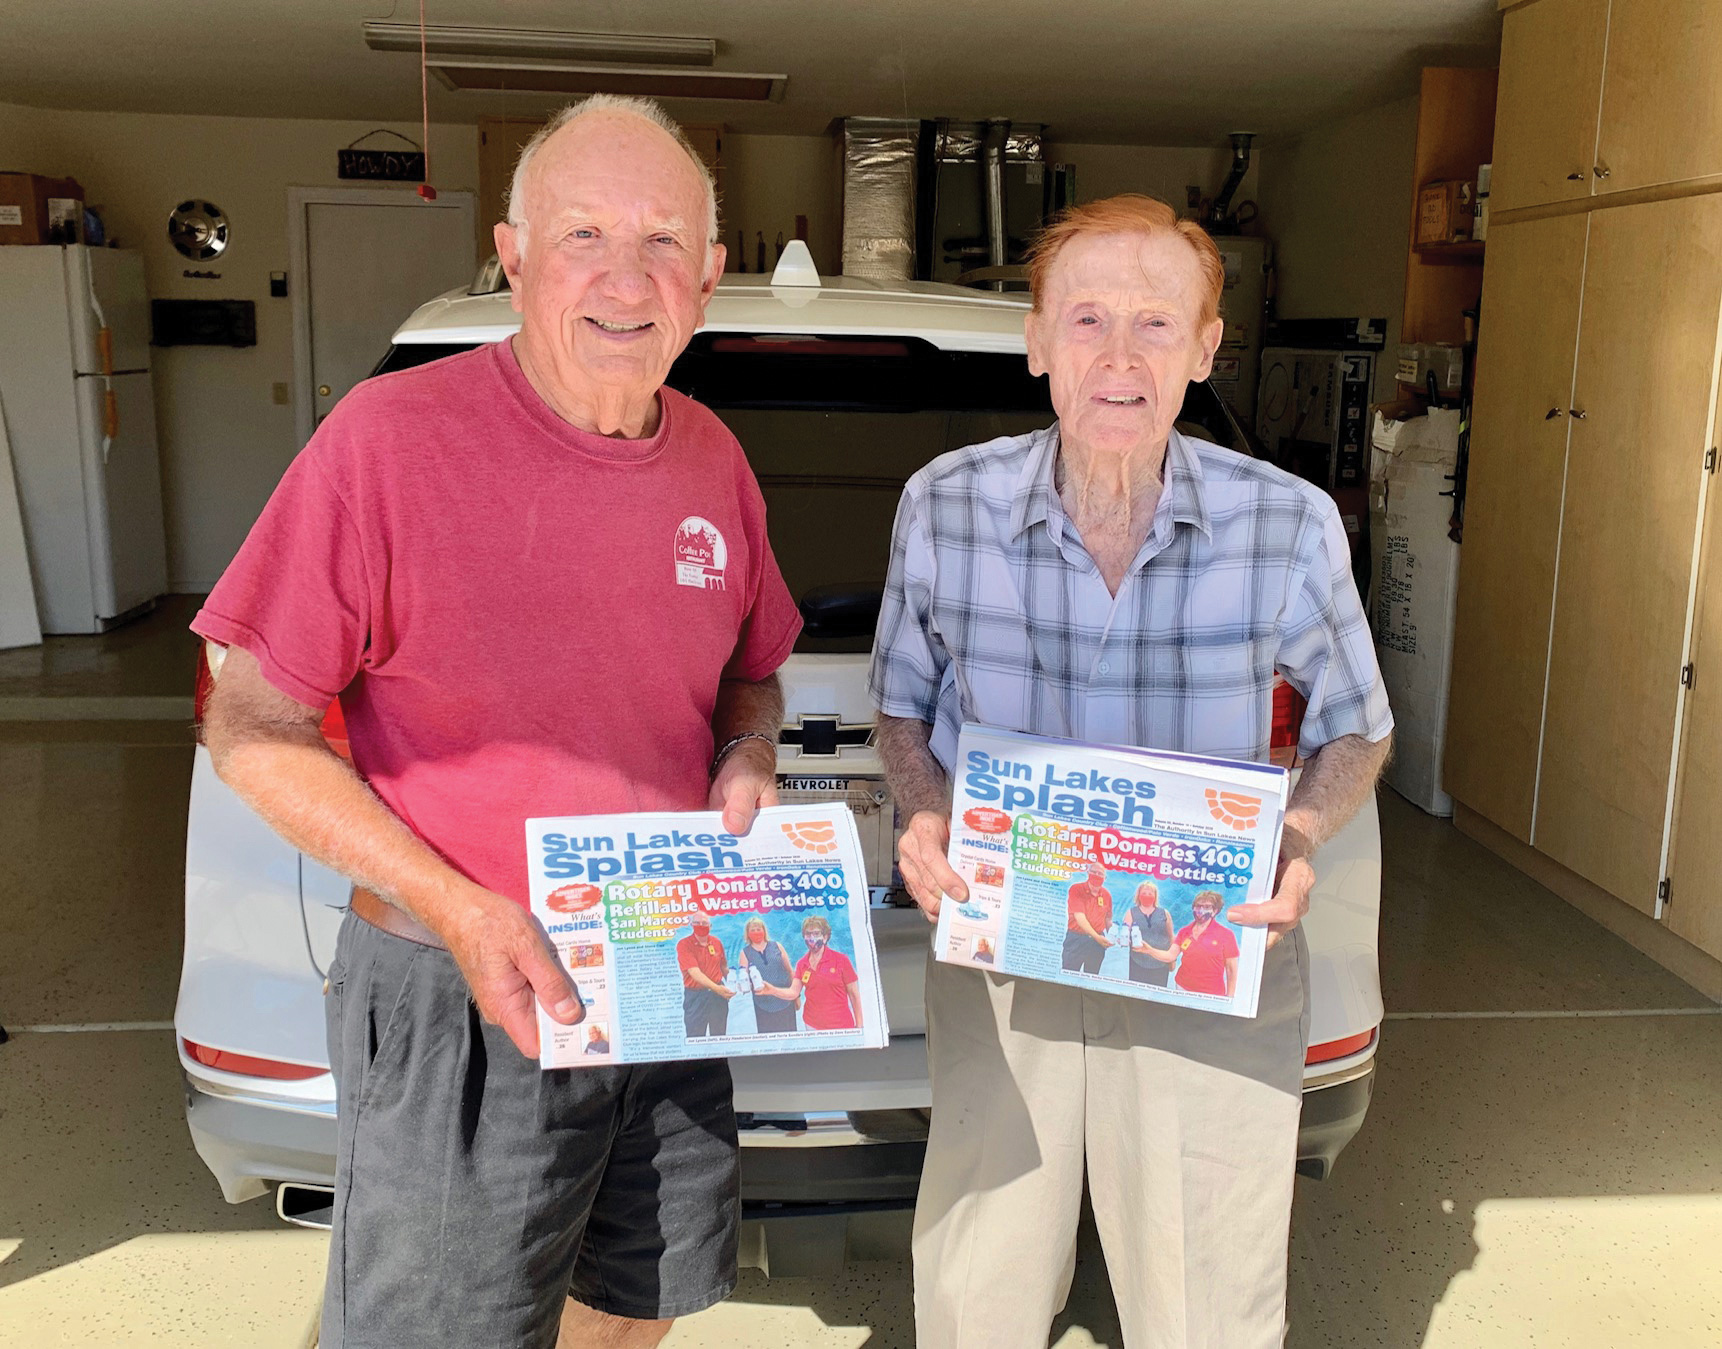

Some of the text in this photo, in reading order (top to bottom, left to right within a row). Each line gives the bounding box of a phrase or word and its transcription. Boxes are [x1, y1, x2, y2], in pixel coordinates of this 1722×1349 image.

[344, 153, 418, 176] HOWDY
[1324, 363, 1334, 427] SAMSUNG
[967, 751, 1156, 799] Sun Lakes
[965, 773, 1154, 827] Splash
[542, 830, 738, 853] Sun Lakes
[962, 838, 1009, 853] INSIDE:
[982, 834, 1008, 846] What's
[1017, 818, 1251, 870] Rotary Donates 400
[543, 847, 744, 882] Splash
[1013, 859, 1072, 879] Students
[1015, 848, 1088, 872] San Marcos
[1016, 836, 1249, 885] Refillable Water Bottles to
[608, 872, 843, 901] Rotary Donates 400
[571, 912, 601, 922] What's
[609, 893, 847, 918] Refillable Water Bottles to
[548, 920, 603, 934] INSIDE:
[610, 916, 690, 929] San Marcos
[611, 927, 675, 941] Students
